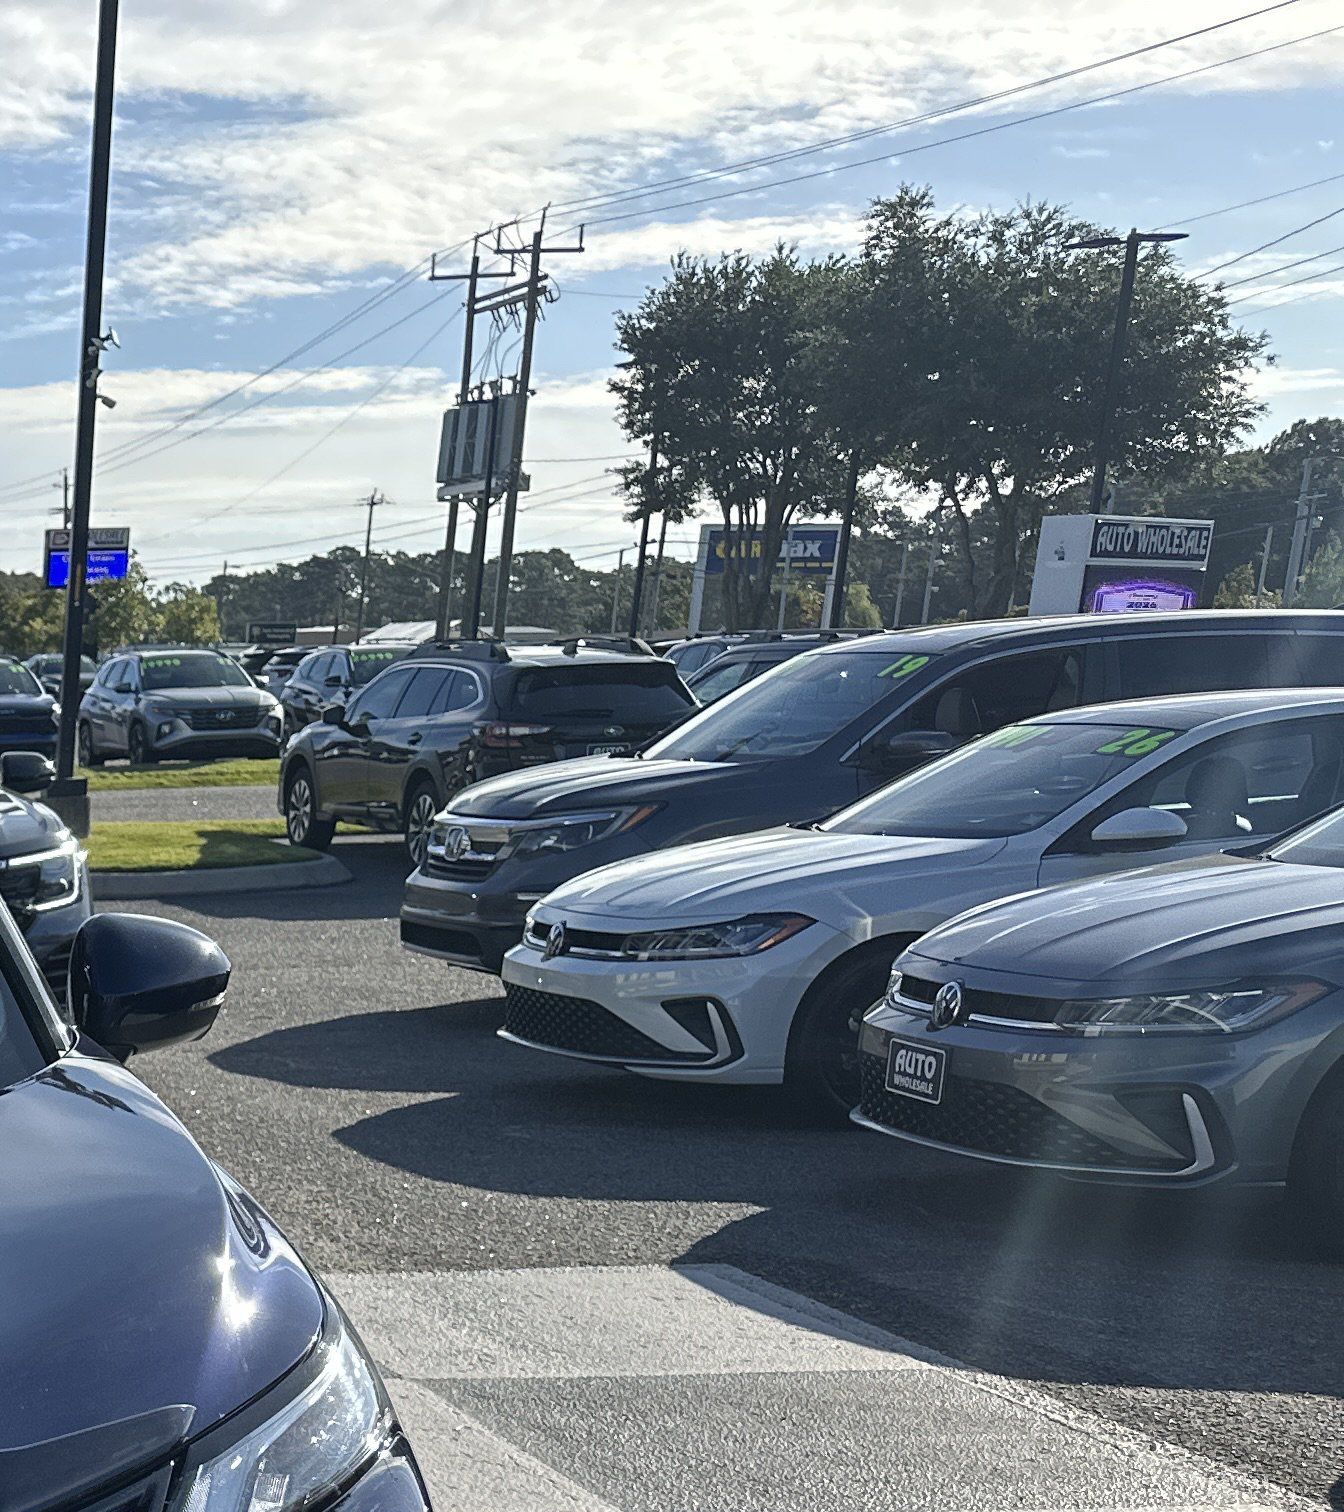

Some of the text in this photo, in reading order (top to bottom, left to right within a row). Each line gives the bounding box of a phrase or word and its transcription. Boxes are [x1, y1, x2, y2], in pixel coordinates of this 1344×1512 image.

[1097, 525, 1209, 556] AUTO WHOLESALE
[877, 655, 929, 678] 19
[1096, 728, 1176, 757] 26
[895, 1049, 937, 1079] AUTO
[893, 1074, 934, 1095] WHOLESALE
